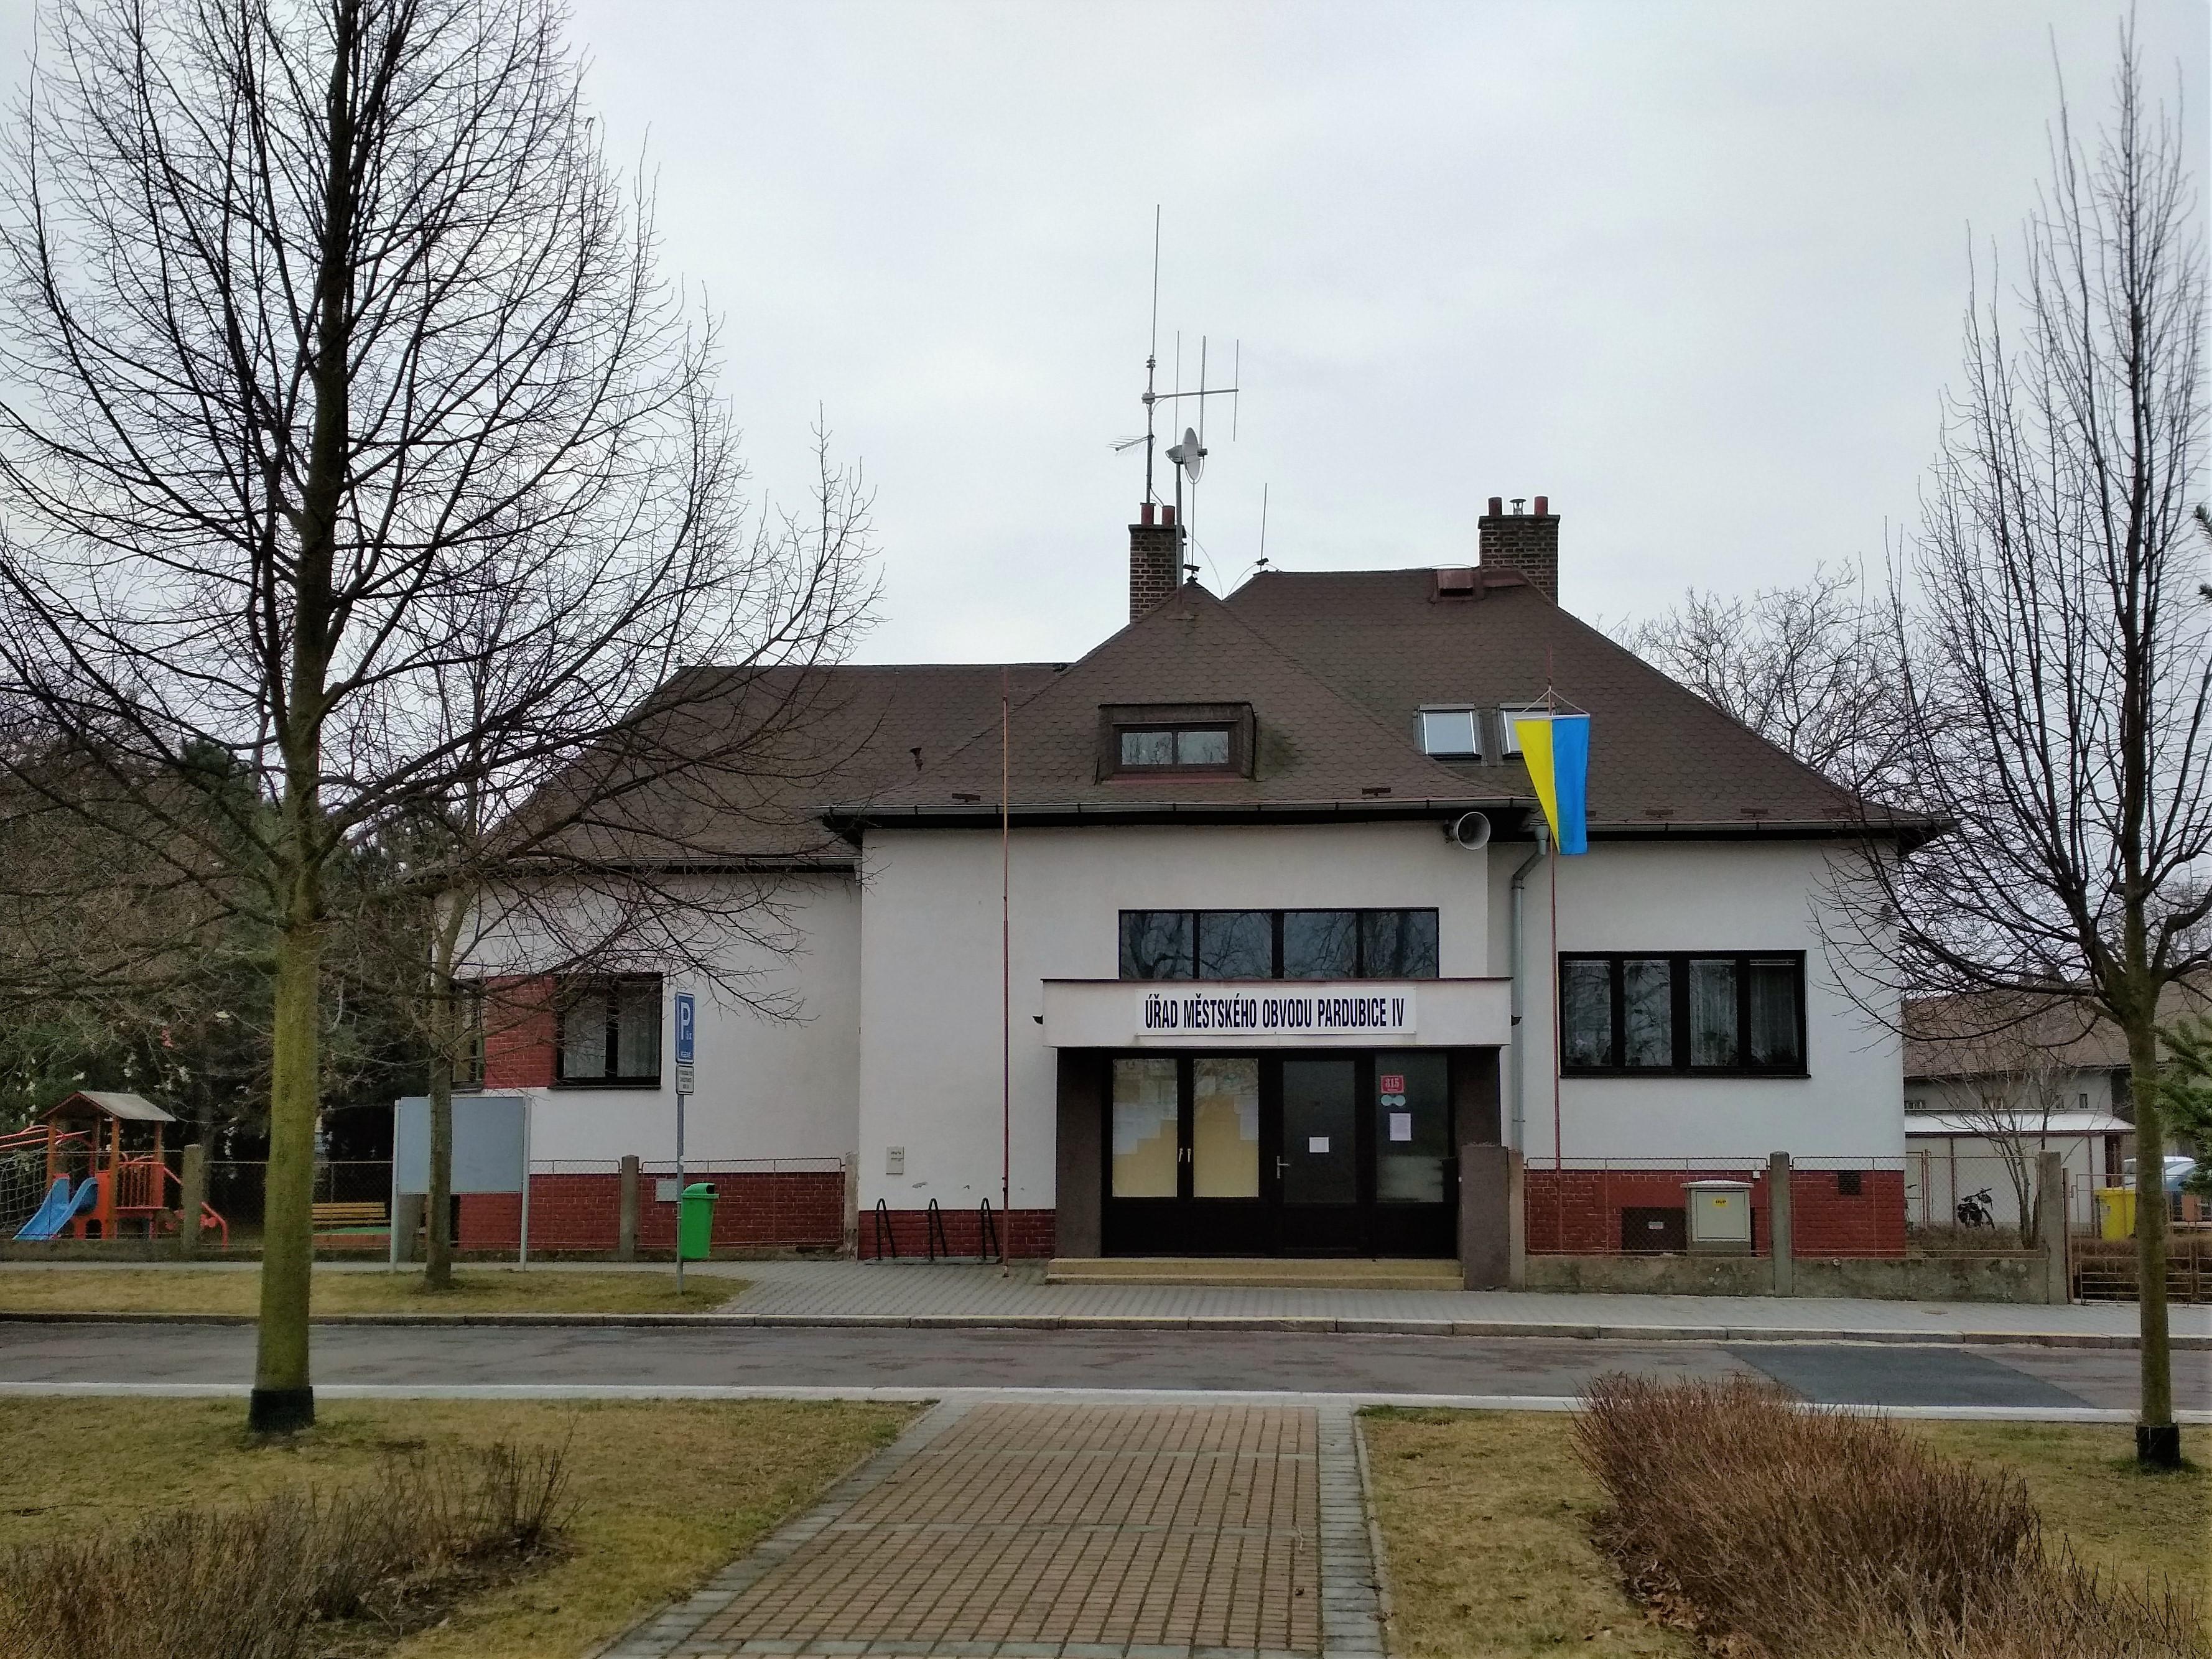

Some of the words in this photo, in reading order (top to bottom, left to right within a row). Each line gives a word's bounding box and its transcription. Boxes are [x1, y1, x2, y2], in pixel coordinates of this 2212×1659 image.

[681, 1001, 691, 1040] P
[1145, 993, 1178, 1029] ÚŘAD
[1184, 993, 1257, 1028] MĚSTSKÉHO
[1262, 998, 1312, 1028] OBVODU
[1317, 998, 1387, 1028] PARDUBICE
[1392, 998, 1405, 1027] IV
